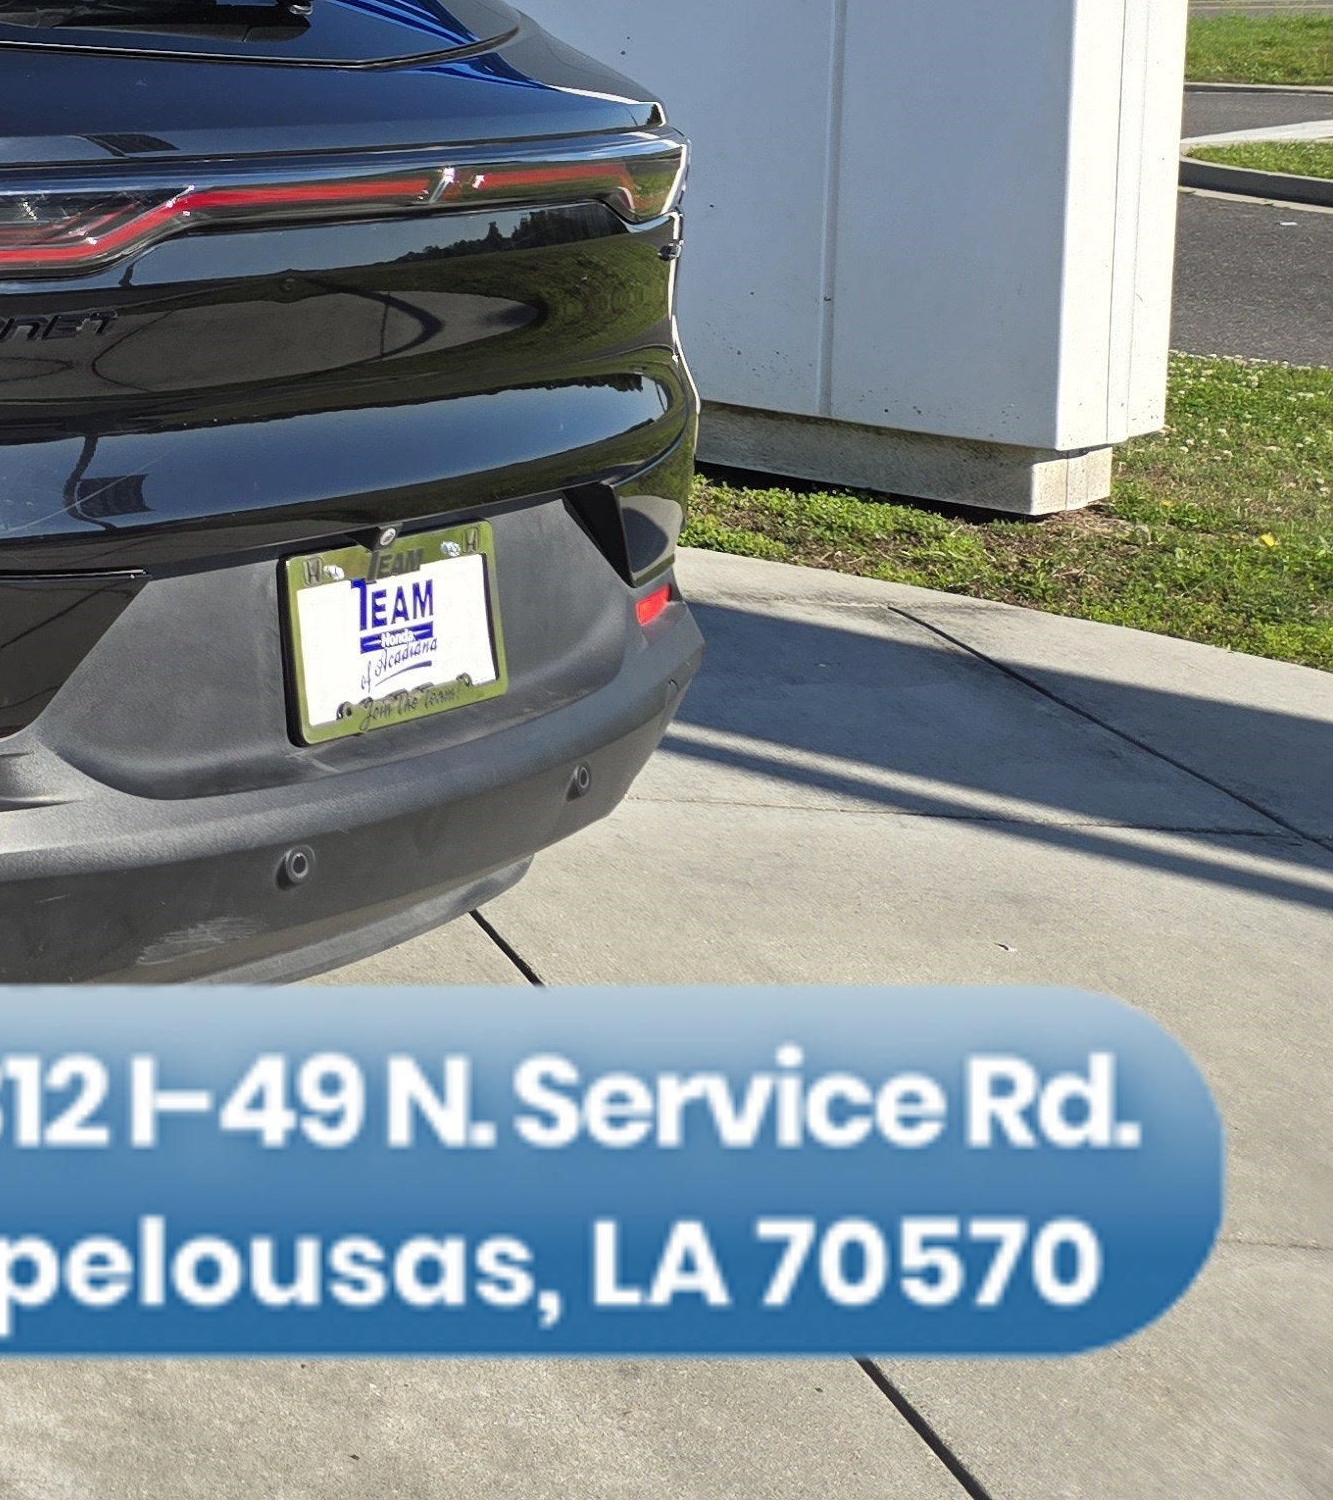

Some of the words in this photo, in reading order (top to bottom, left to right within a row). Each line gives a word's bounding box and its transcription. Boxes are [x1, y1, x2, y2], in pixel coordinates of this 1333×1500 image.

[364, 547, 425, 585] TEAM
[351, 579, 434, 631] TEAM
[361, 660, 372, 693] of
[374, 638, 438, 677] Acadiana
